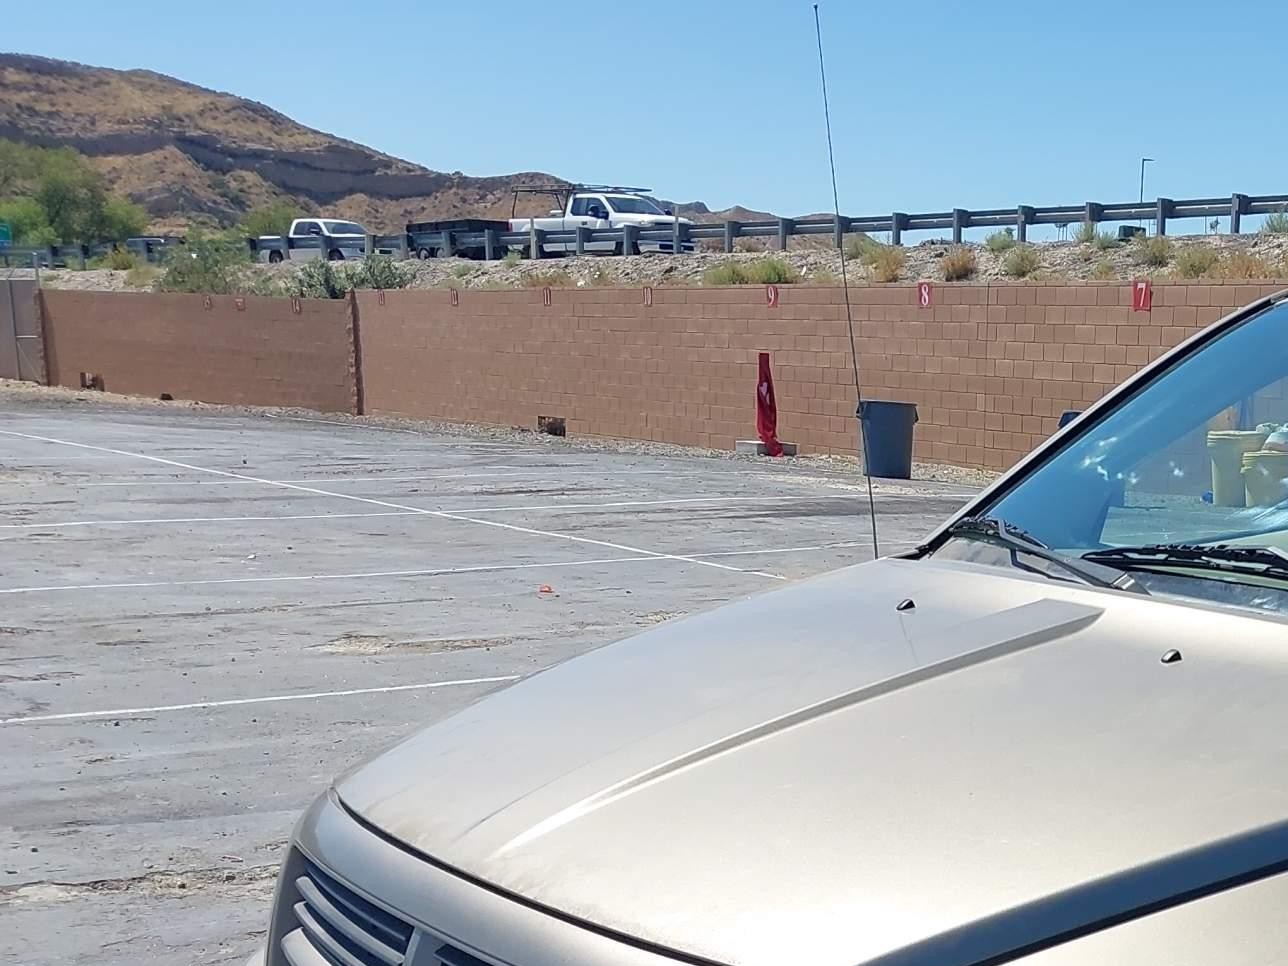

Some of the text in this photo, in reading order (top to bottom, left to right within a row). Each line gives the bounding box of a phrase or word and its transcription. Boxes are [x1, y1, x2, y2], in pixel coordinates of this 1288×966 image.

[768, 286, 775, 306] 9
[921, 284, 929, 306] 8
[1136, 282, 1146, 307] 7
